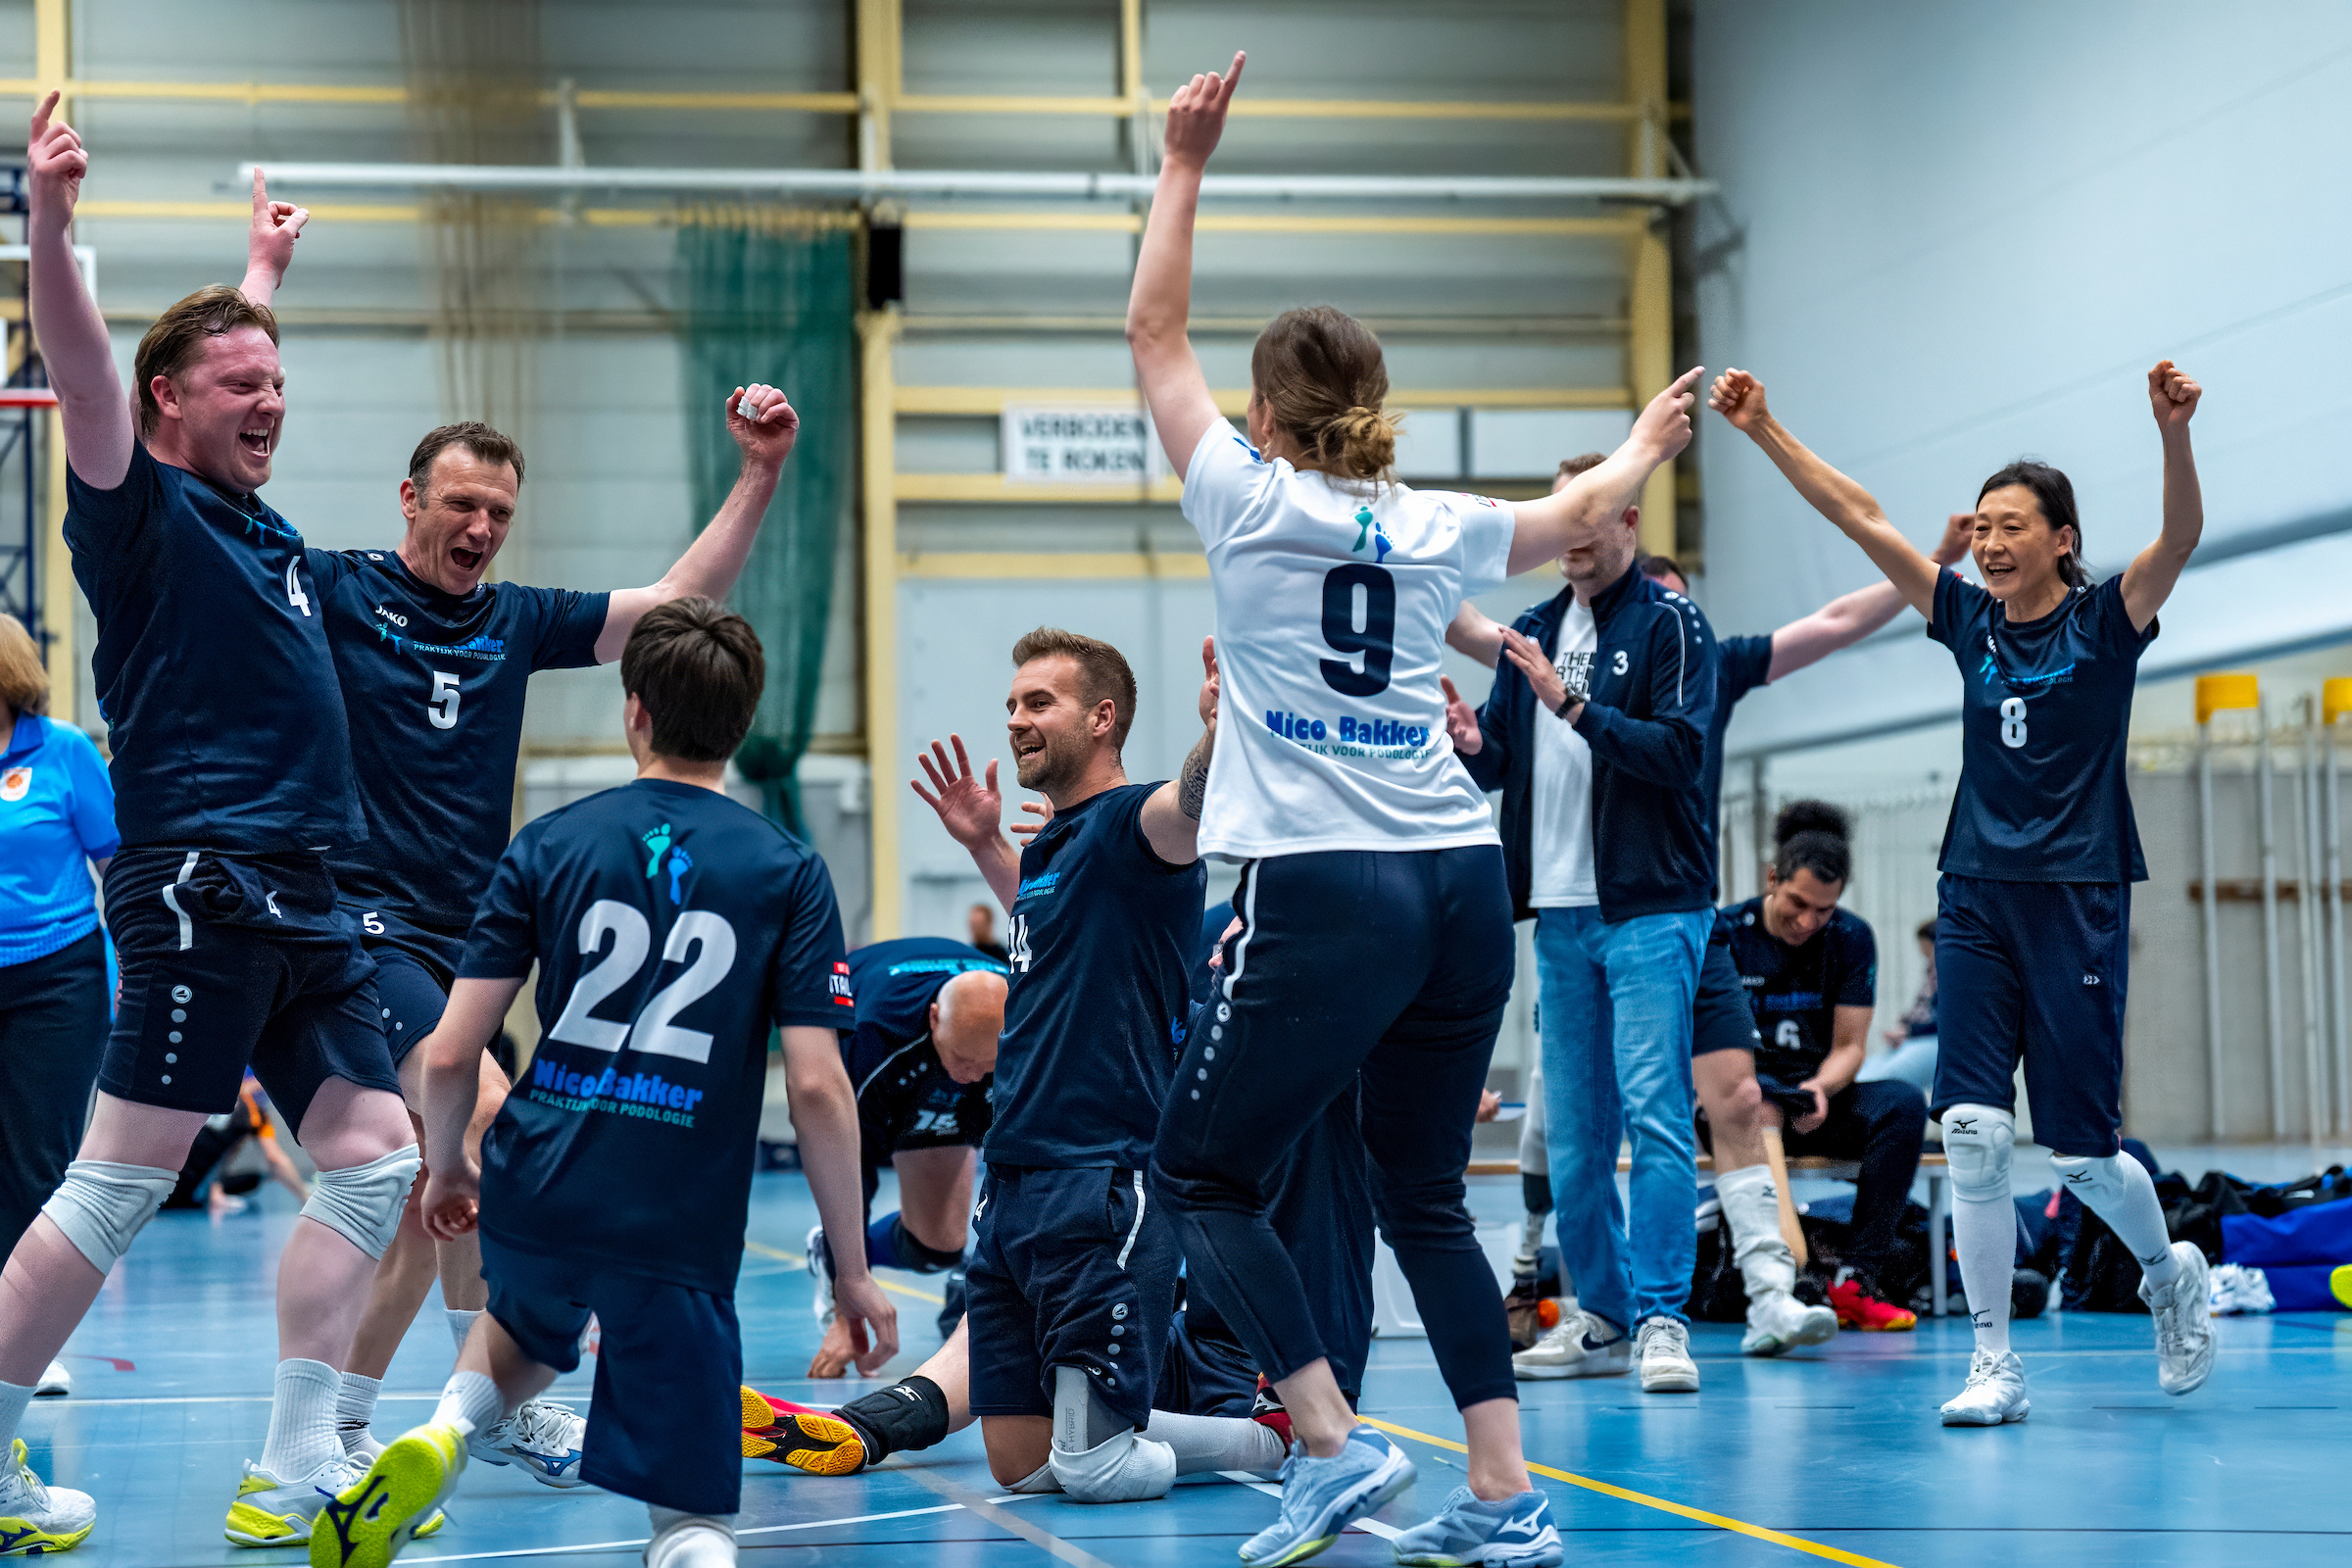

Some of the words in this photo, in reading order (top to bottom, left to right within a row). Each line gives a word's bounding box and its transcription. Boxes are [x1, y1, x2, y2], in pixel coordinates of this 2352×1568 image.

[1026, 448, 1049, 470] TE
[286, 555, 312, 616] 4
[374, 605, 409, 627] JAKO
[1320, 563, 1396, 697] 9
[1563, 651, 1590, 666] THE
[1612, 650, 1630, 676] 3
[427, 670, 461, 729] 5
[1266, 710, 1326, 741] Nico
[1340, 716, 1430, 747] Bakker
[2000, 697, 2028, 749] 8
[1332, 745, 1366, 758] VOOR
[363, 911, 385, 934] 5
[1008, 914, 1033, 974] 14
[548, 899, 737, 1064] 22
[532, 1057, 598, 1099] Nico
[594, 1066, 704, 1111] Bakker
[618, 1102, 696, 1128] PODOLOGIE
